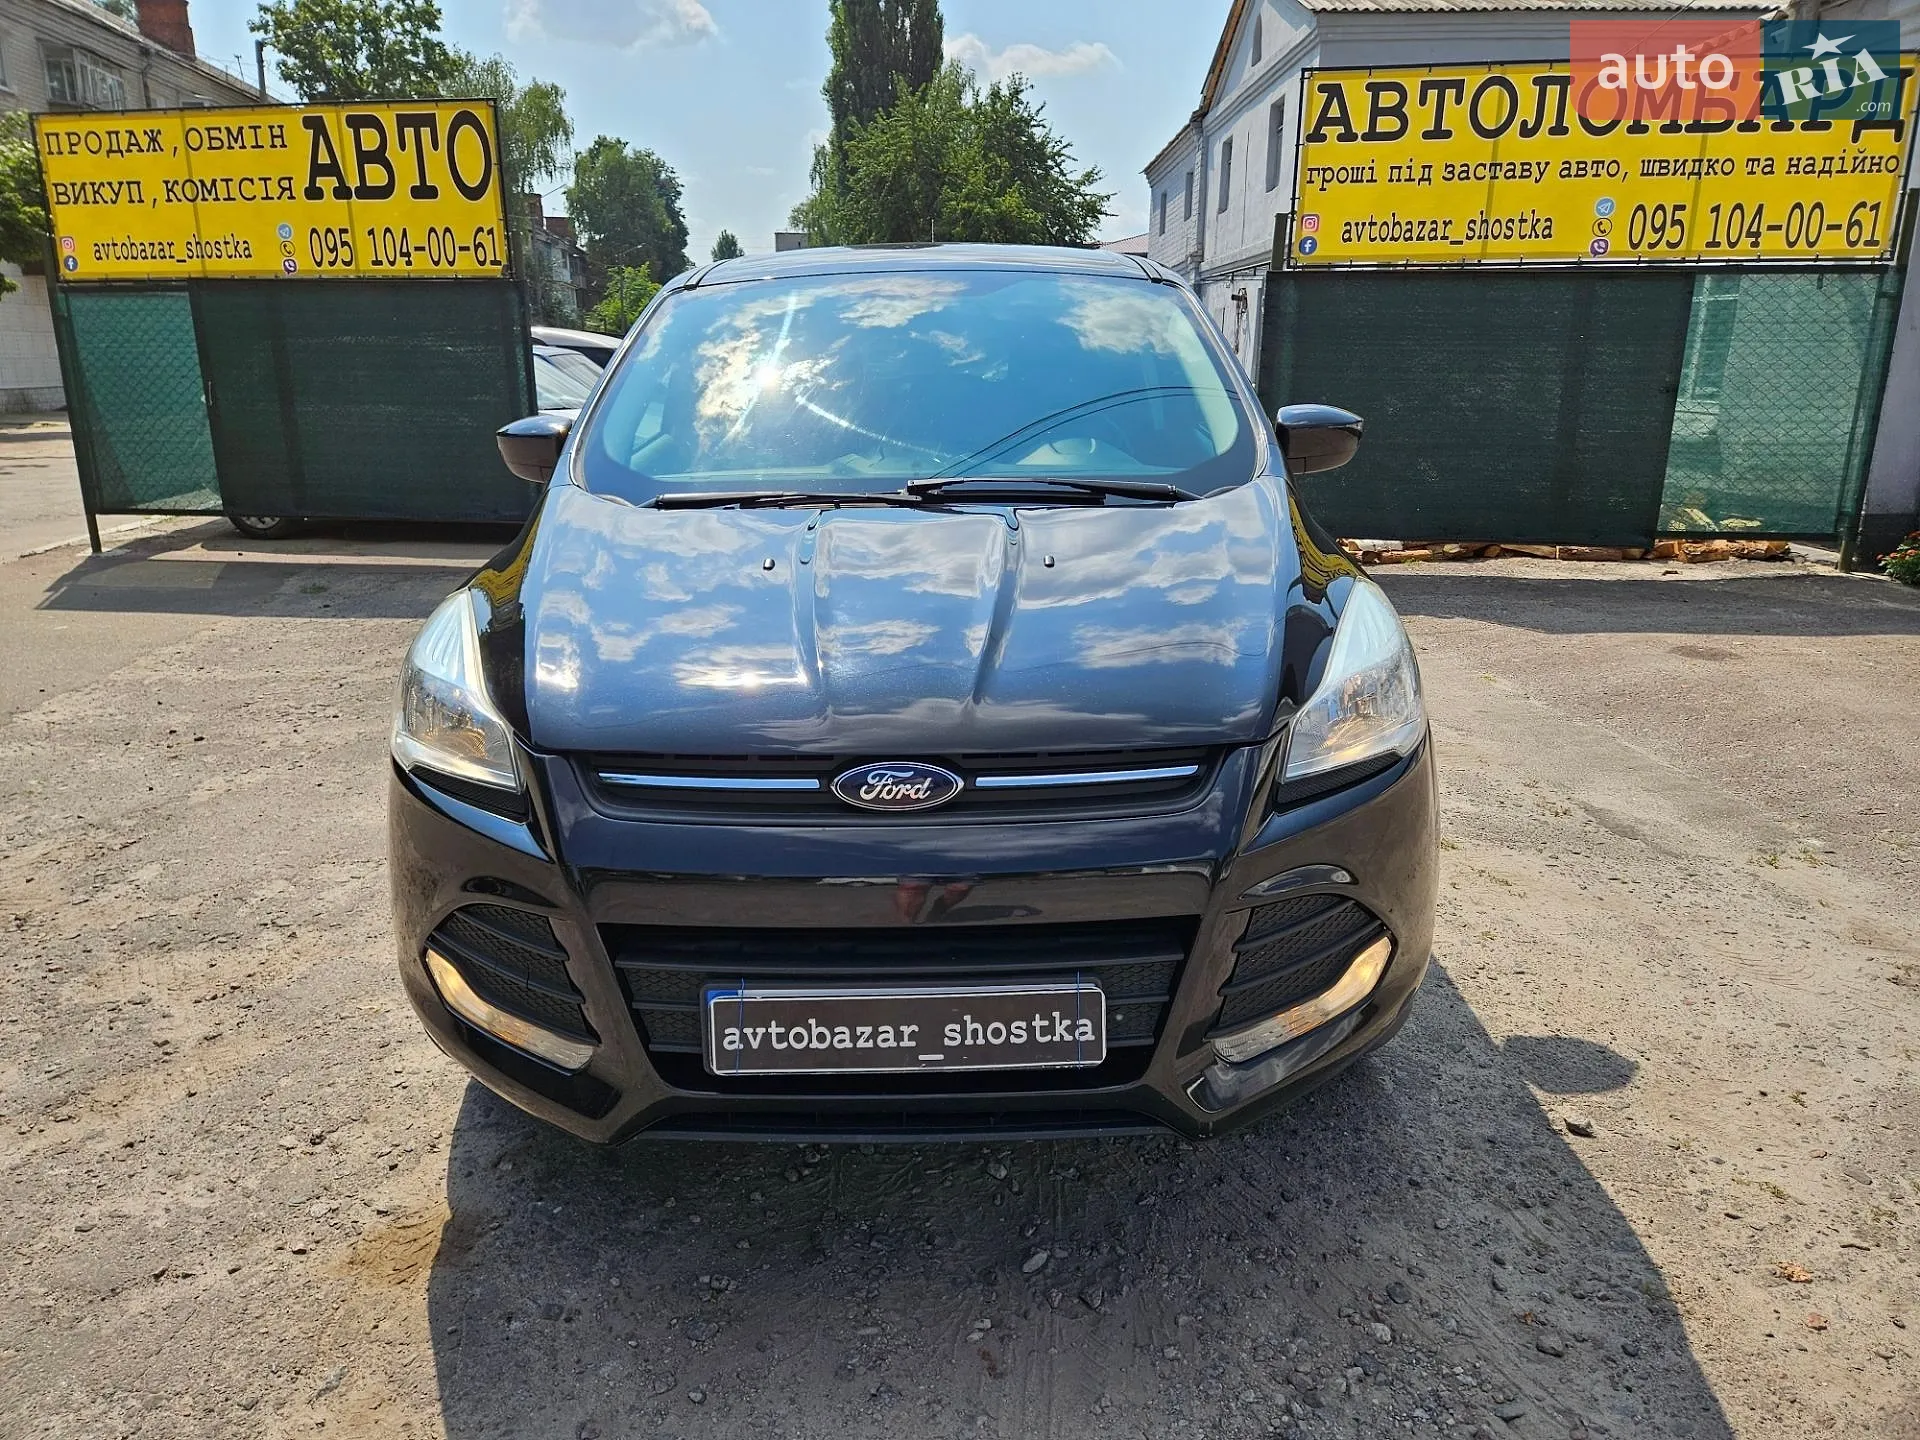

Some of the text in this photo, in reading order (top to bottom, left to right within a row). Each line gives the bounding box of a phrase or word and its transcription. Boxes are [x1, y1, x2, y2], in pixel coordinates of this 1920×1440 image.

[1306, 67, 1917, 144] АВТОЛОМБАРД
[302, 109, 493, 202] АВТО
[1306, 148, 1901, 191] гроші під заставу авто, швидко та надійно
[1341, 209, 1554, 246] avtobazar_shostka
[1628, 201, 1882, 250] 095 104-00-61
[93, 234, 253, 262] avtobazar_shostka
[310, 227, 502, 267] 095 104-00-61
[859, 770, 932, 801] Ford
